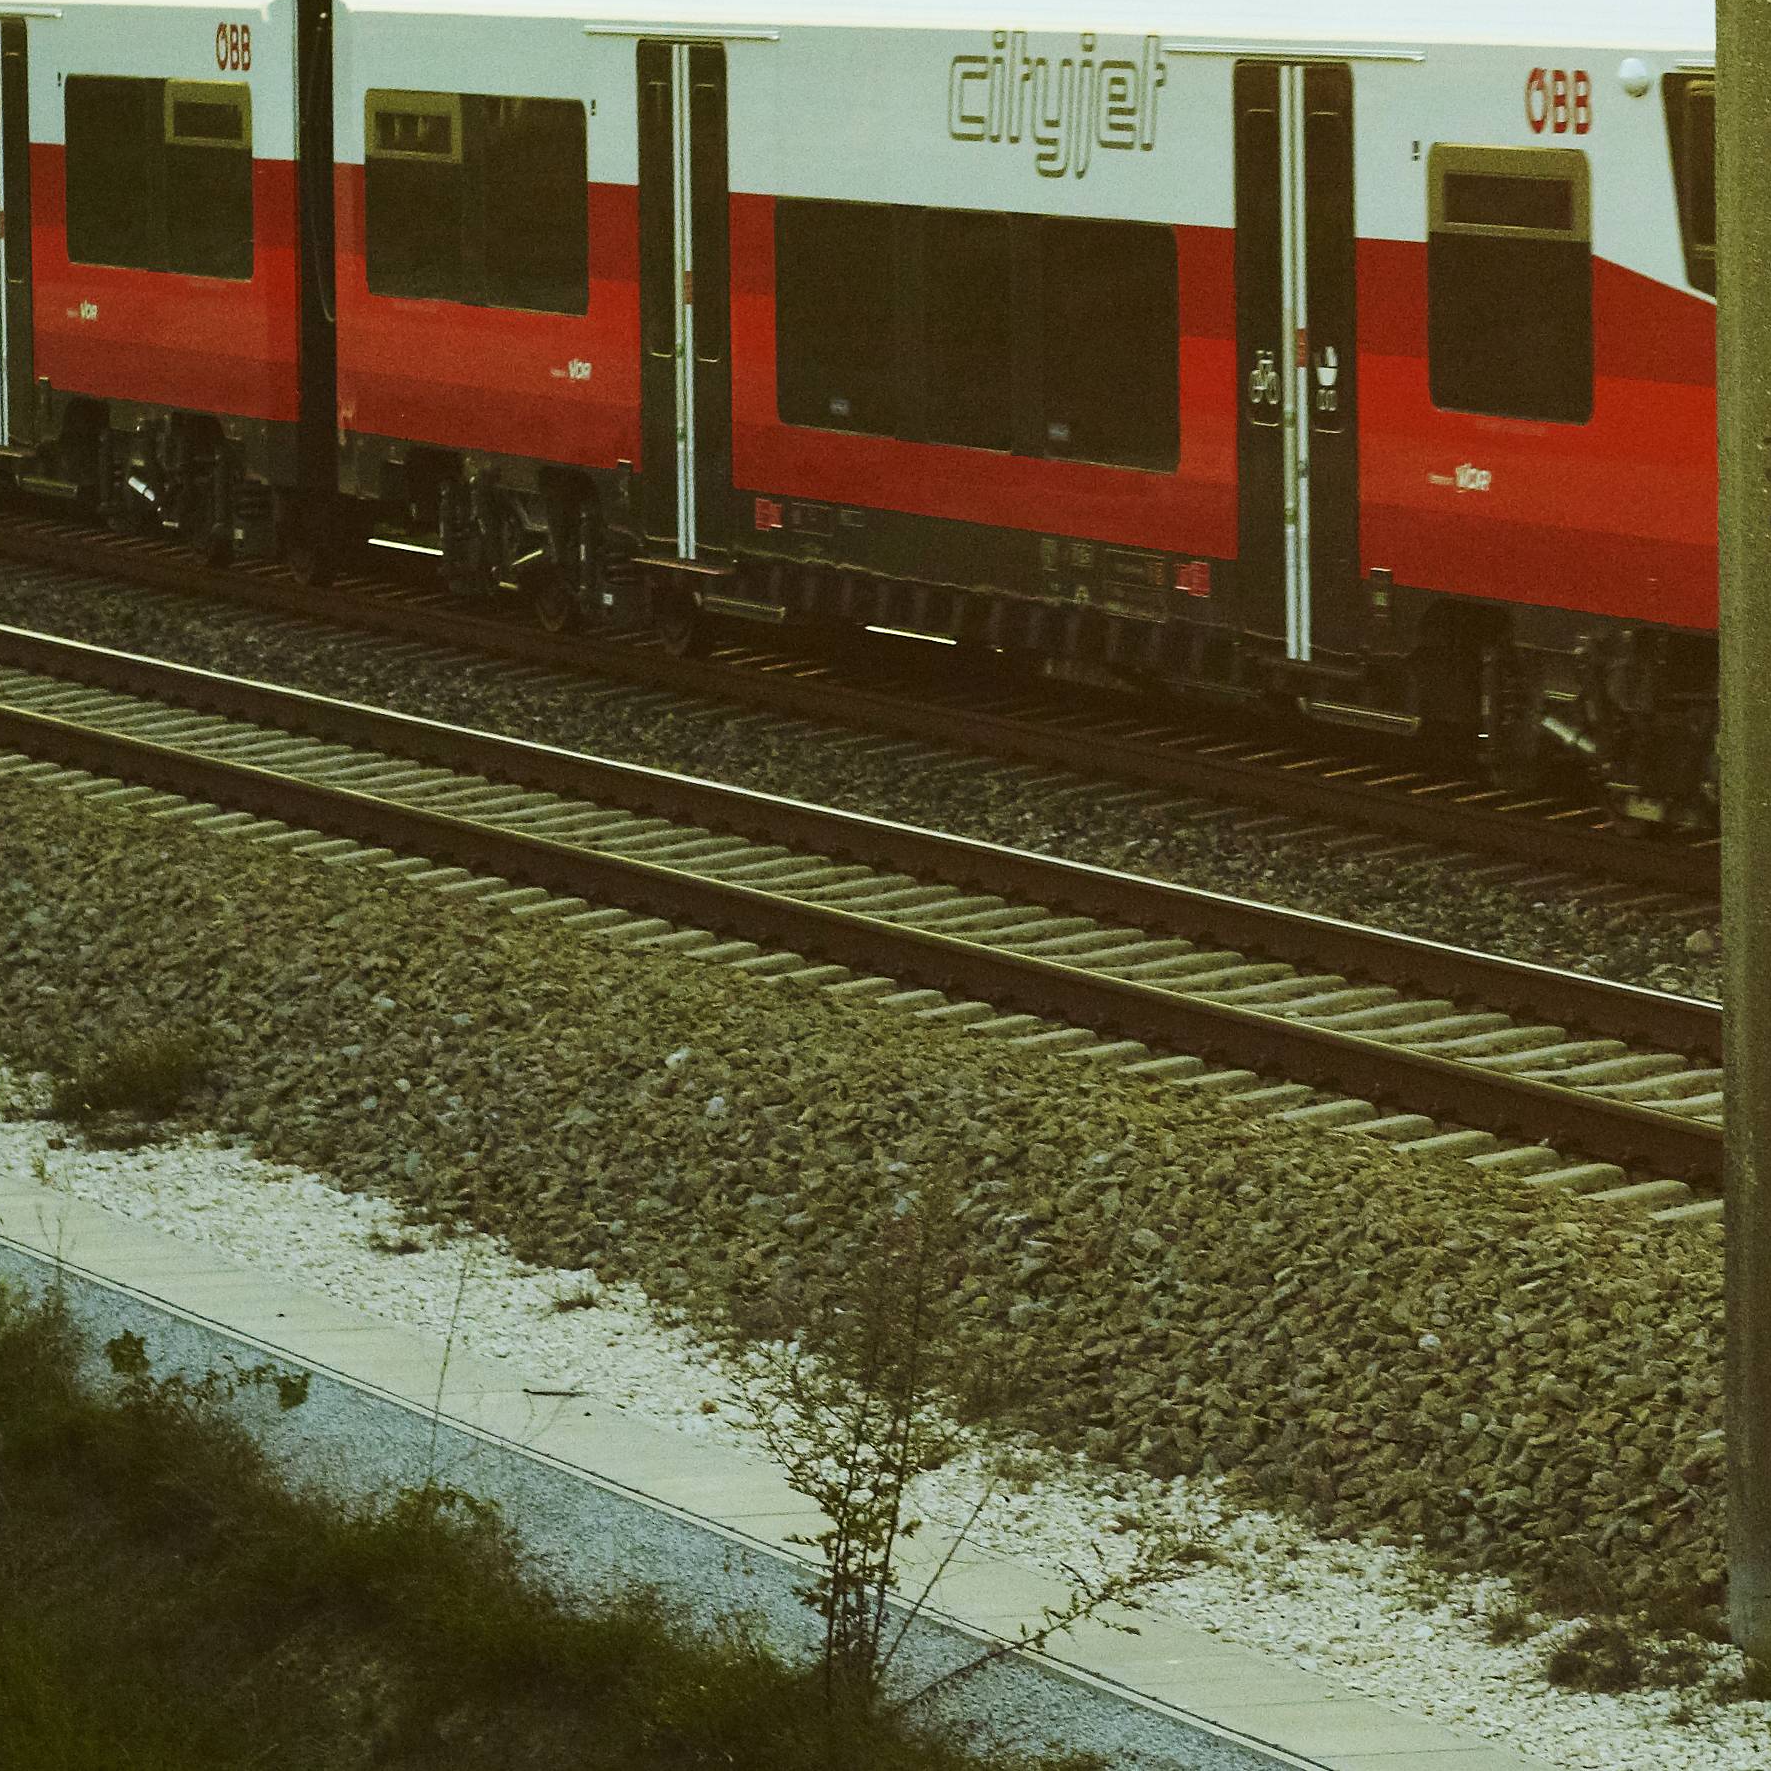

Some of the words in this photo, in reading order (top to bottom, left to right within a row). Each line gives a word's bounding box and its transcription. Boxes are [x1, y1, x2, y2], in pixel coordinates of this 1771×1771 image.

[216, 22, 251, 71] ÖBB
[948, 31, 1166, 179] cityjet
[1525, 68, 1592, 134] ÖBB
